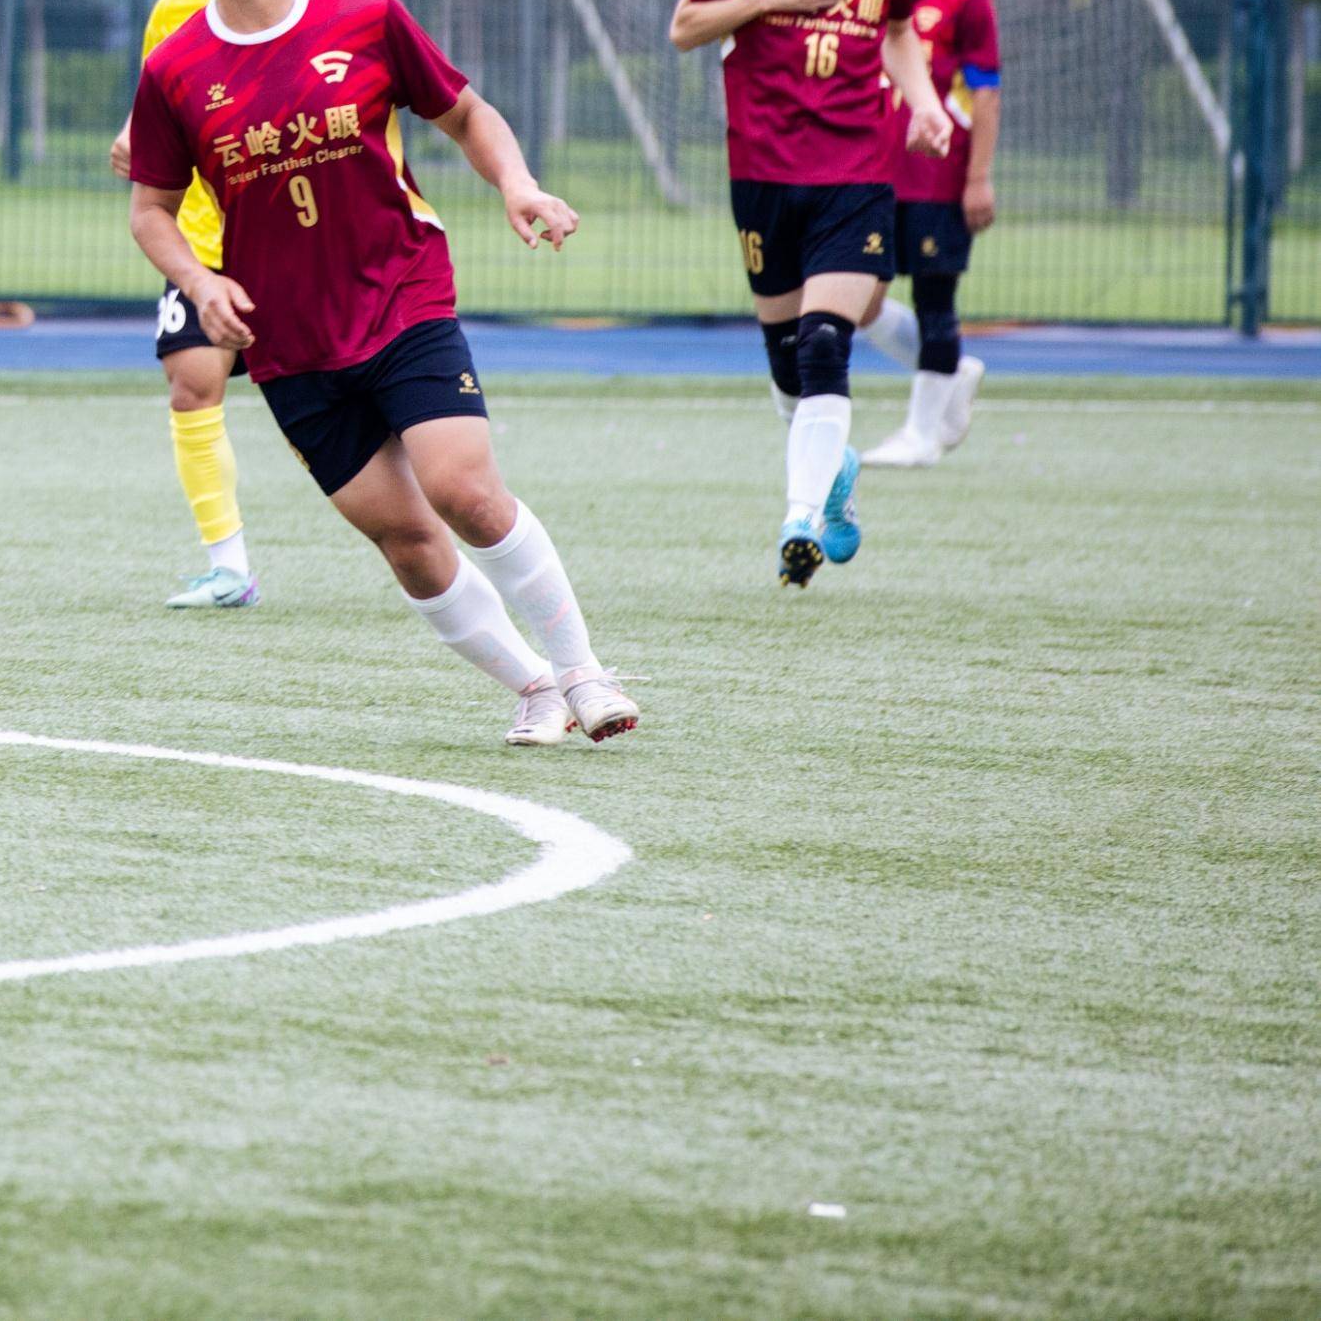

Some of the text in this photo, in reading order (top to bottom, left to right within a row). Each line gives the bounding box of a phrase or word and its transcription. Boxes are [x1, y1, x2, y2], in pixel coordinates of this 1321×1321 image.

[804, 32, 840, 79] 16
[213, 103, 361, 168] 云岭火眼
[261, 156, 314, 176] Farther
[315, 145, 364, 164] Clearer
[288, 175, 319, 228] 9
